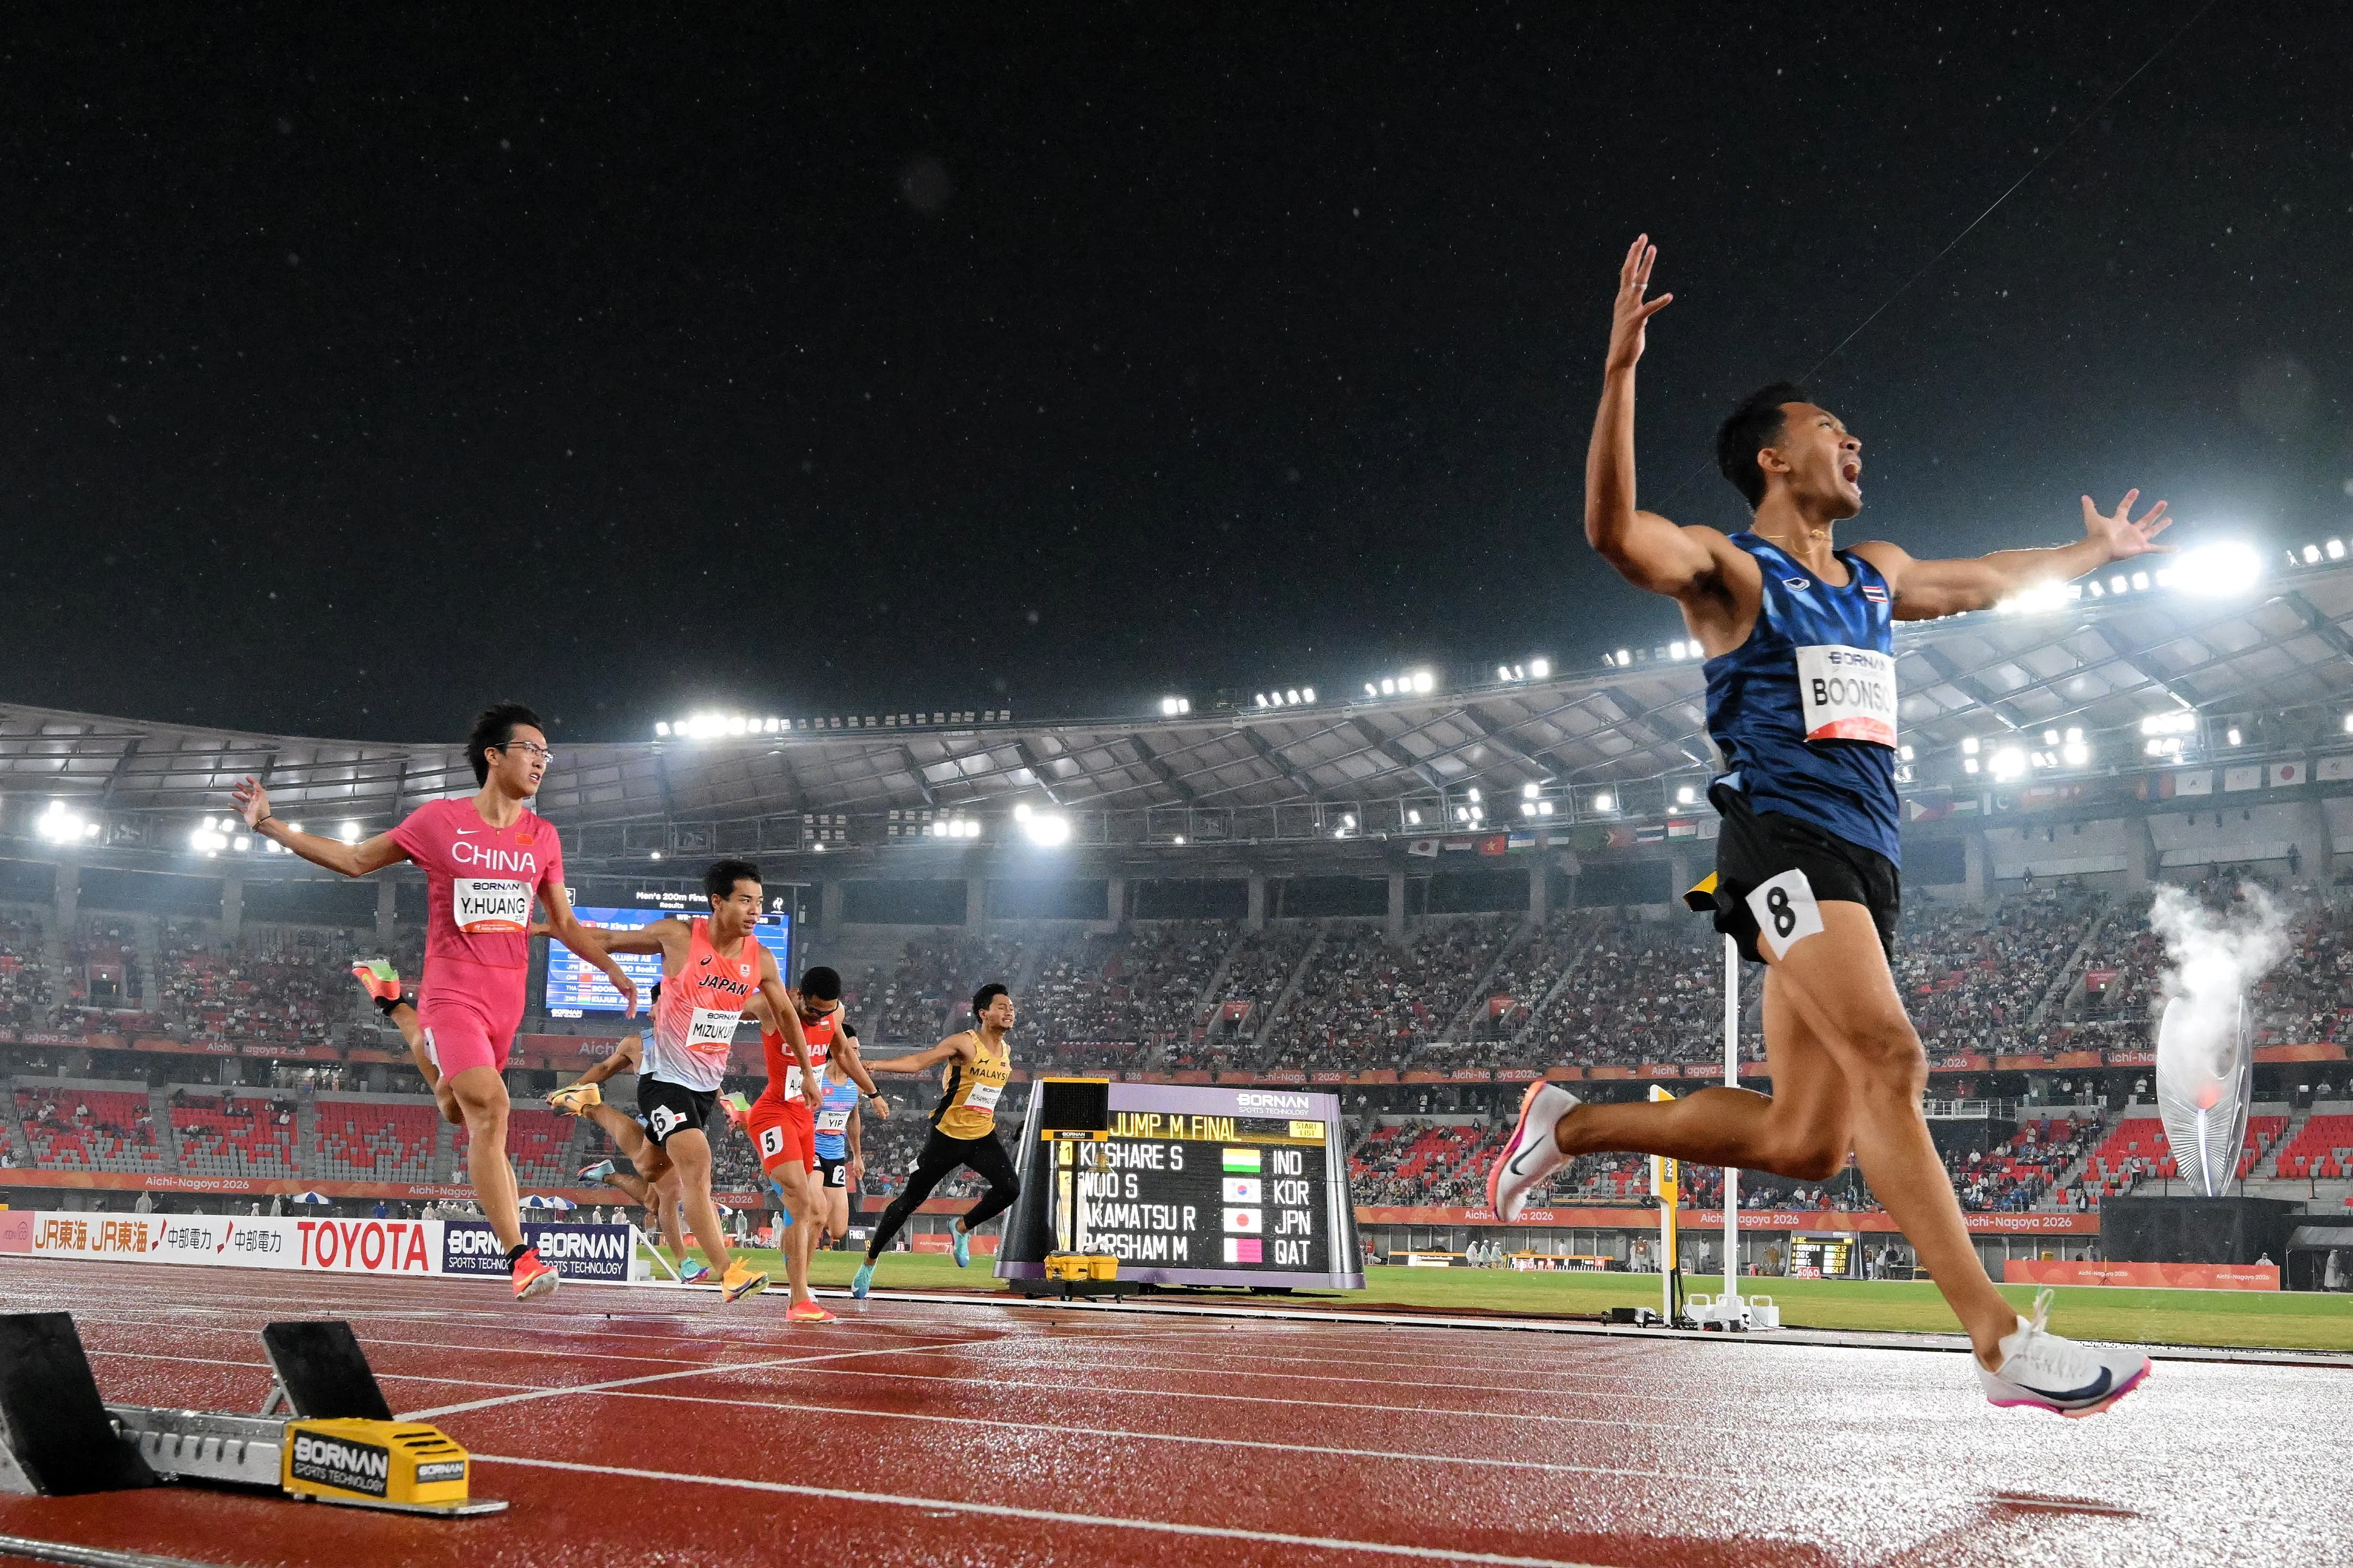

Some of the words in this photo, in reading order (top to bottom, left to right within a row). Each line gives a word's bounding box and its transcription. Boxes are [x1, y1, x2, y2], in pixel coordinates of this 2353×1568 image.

[1812, 678, 1891, 713] BOONSO
[452, 842, 536, 873] CHINA
[472, 882, 520, 890] BORNAN
[636, 892, 661, 900] Men's
[662, 893, 687, 901] 200m
[688, 893, 708, 902] Fina
[461, 897, 525, 914] Y.HUANG
[1767, 886, 1796, 939] 8
[699, 974, 749, 996] JAPAN
[693, 1022, 734, 1040] MIZUKU
[579, 1042, 620, 1056] Aichi
[507, 1057, 525, 1066] 026
[1719, 1064, 1743, 1074] 26
[1941, 1058, 1967, 1068] 2026
[969, 1067, 1008, 1081] MALAYSI
[1253, 1072, 1315, 1084] Ahi-Nagoa
[1317, 1072, 1341, 1081] 2026
[1451, 1070, 1513, 1081] Aichi-Naoya
[1236, 1093, 1309, 1109] BORNAN
[1267, 1108, 1309, 1116] TECHNOLOGY
[653, 1112, 666, 1132] 6
[828, 1119, 843, 1127] YIP
[1110, 1112, 1161, 1138] JUMP
[1170, 1114, 1183, 1139] M
[1192, 1115, 1242, 1142] FINAL
[765, 1131, 776, 1152] 5
[1170, 1146, 1183, 1170] S
[1273, 1150, 1302, 1176] IND
[838, 1168, 844, 1182] 2
[145, 1176, 220, 1190] Aichi-Nagoya
[223, 1180, 249, 1189] 2026
[1081, 1172, 1118, 1197] WOO
[1125, 1174, 1138, 1198] S
[1274, 1180, 1309, 1205] KOR
[728, 1195, 753, 1204] 2026
[1183, 1206, 1196, 1231] R
[1275, 1210, 1311, 1235] JPN
[1465, 1210, 1528, 1223] Aichi-ya
[1530, 1211, 1553, 1221] 2026
[1700, 1212, 1771, 1227] Aichiagoya
[1773, 1215, 1799, 1225] 2026
[1963, 1216, 2039, 1229] Aichi-Nagoya
[2043, 1217, 2072, 1227] 2026
[35, 1219, 88, 1250] JR東海
[92, 1220, 148, 1253] JR東海
[168, 1227, 212, 1250] 中部電力
[235, 1229, 282, 1253] 中部電力
[849, 1229, 866, 1240] FINISH
[297, 1220, 429, 1271] TOYOTA
[447, 1230, 528, 1256] BORN
[537, 1232, 625, 1260] BORNAN
[1173, 1236, 1187, 1261] M
[1275, 1240, 1311, 1265] QAT
[449, 1257, 476, 1269] SPORTS
[478, 1258, 511, 1270] TECHNO
[539, 1260, 568, 1273] SPORTS
[570, 1261, 623, 1275] TECHNOLOGY
[294, 1437, 388, 1479] BORNAN
